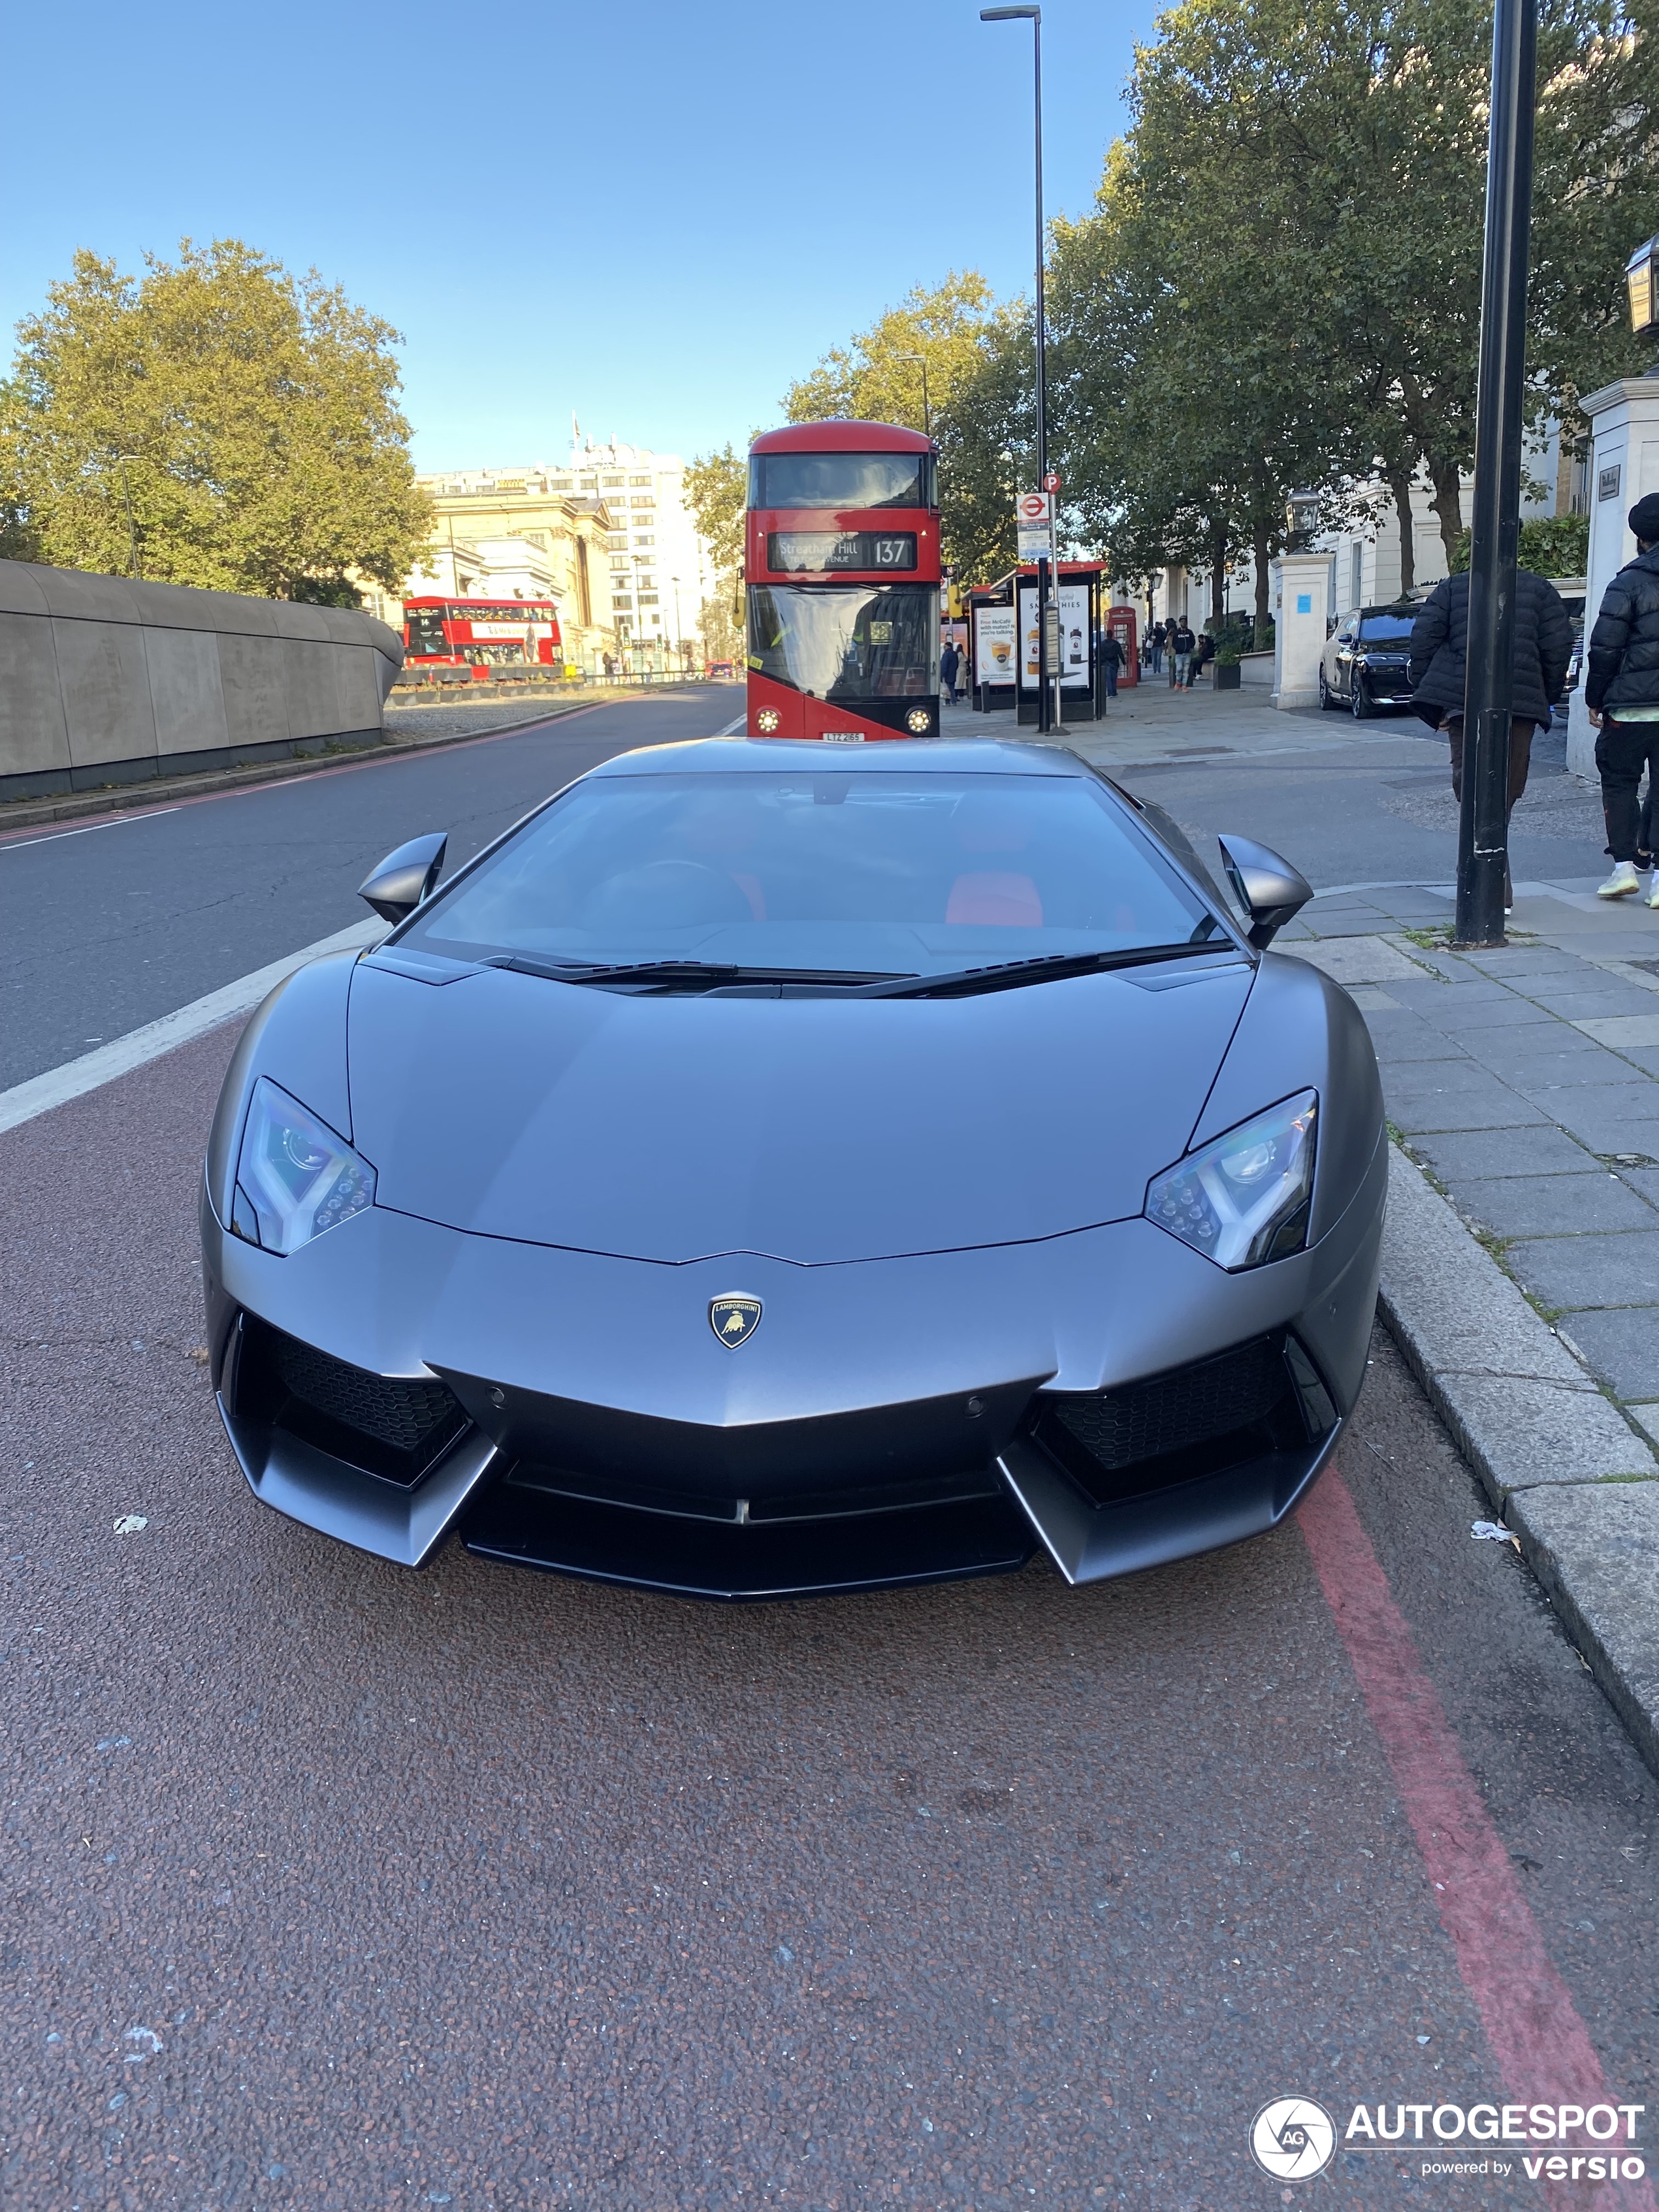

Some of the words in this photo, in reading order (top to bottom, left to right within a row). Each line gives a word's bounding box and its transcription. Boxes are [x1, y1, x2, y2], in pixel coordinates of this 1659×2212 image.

[1048, 477, 1057, 490] P
[781, 542, 835, 554] Streatham
[839, 541, 858, 554] Hill
[876, 540, 905, 563] 137
[1059, 593, 1074, 602] rafted
[715, 1303, 758, 1312] LAMBORGHINI
